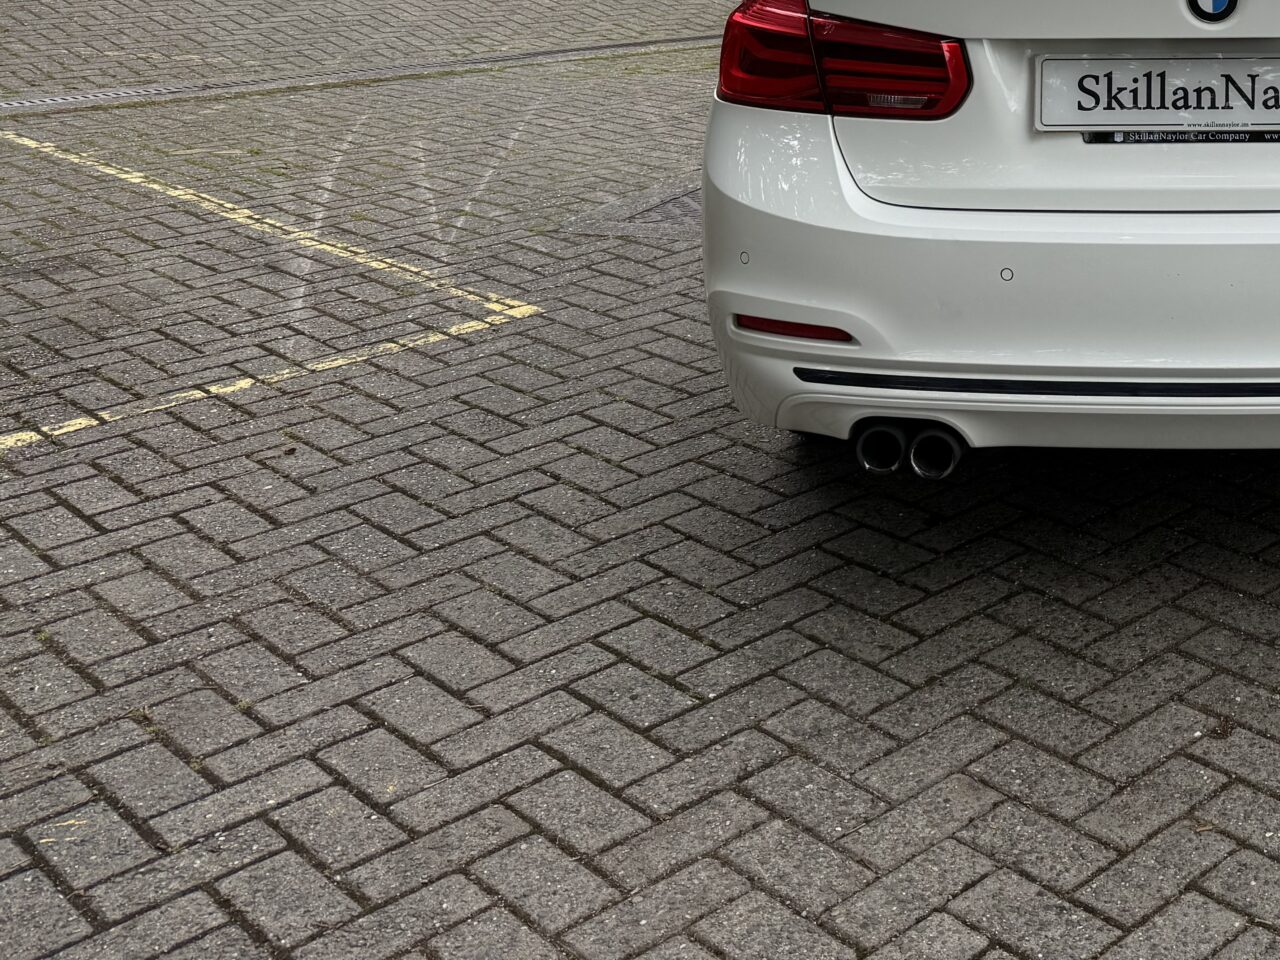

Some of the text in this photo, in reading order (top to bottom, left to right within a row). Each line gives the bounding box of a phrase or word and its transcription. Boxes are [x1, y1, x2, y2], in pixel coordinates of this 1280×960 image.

[1187, 120, 1249, 129] www.skillannaylor.im
[1129, 131, 1188, 142] SkillanNaylor
[1190, 131, 1206, 141] Car
[1208, 131, 1250, 142] Company
